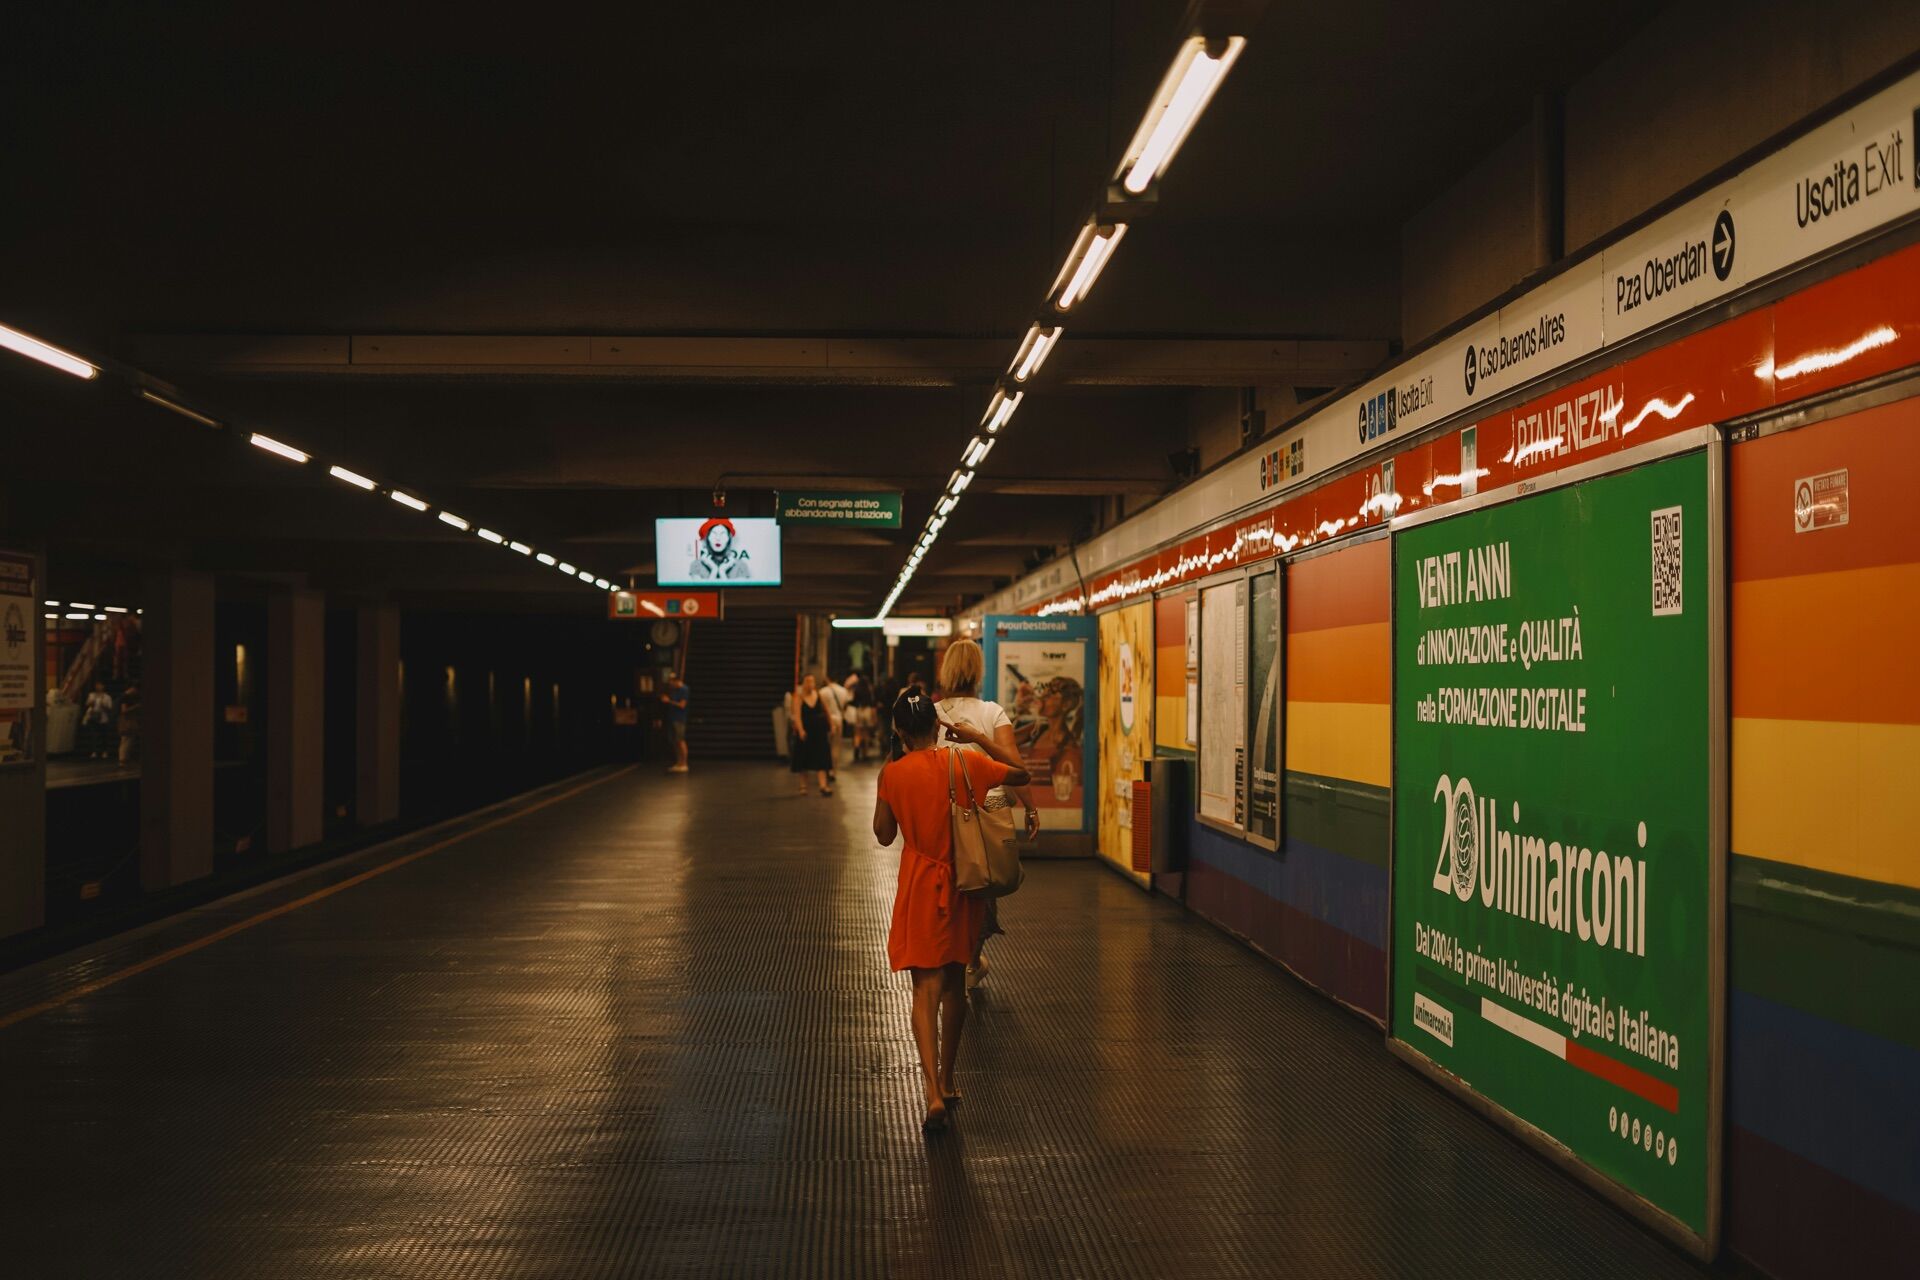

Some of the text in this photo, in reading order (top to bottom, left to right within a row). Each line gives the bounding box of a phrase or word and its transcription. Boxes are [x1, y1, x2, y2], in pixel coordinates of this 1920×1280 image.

[1796, 129, 1903, 228] Uscita Exit
[1616, 241, 1707, 315] P.za Oberdan
[1479, 313, 1565, 380] C.so Buenos Aires
[1397, 375, 1434, 418] Uscita Exit
[785, 508, 893, 519] abbandonare la stazione
[798, 498, 880, 509] Con segnale attivo
[1416, 541, 1511, 608] VENTI ANNI
[1417, 605, 1583, 671] di INNOVAZIONE e QUALITÀ
[1417, 687, 1587, 732] nella FORMAZIONE DIGITALE
[1479, 797, 1647, 957] Unimarconi
[1415, 921, 1679, 1071] Dal 2004 la prima Università digitale Italiana
[1415, 1002, 1452, 1041] unimarconi.it
